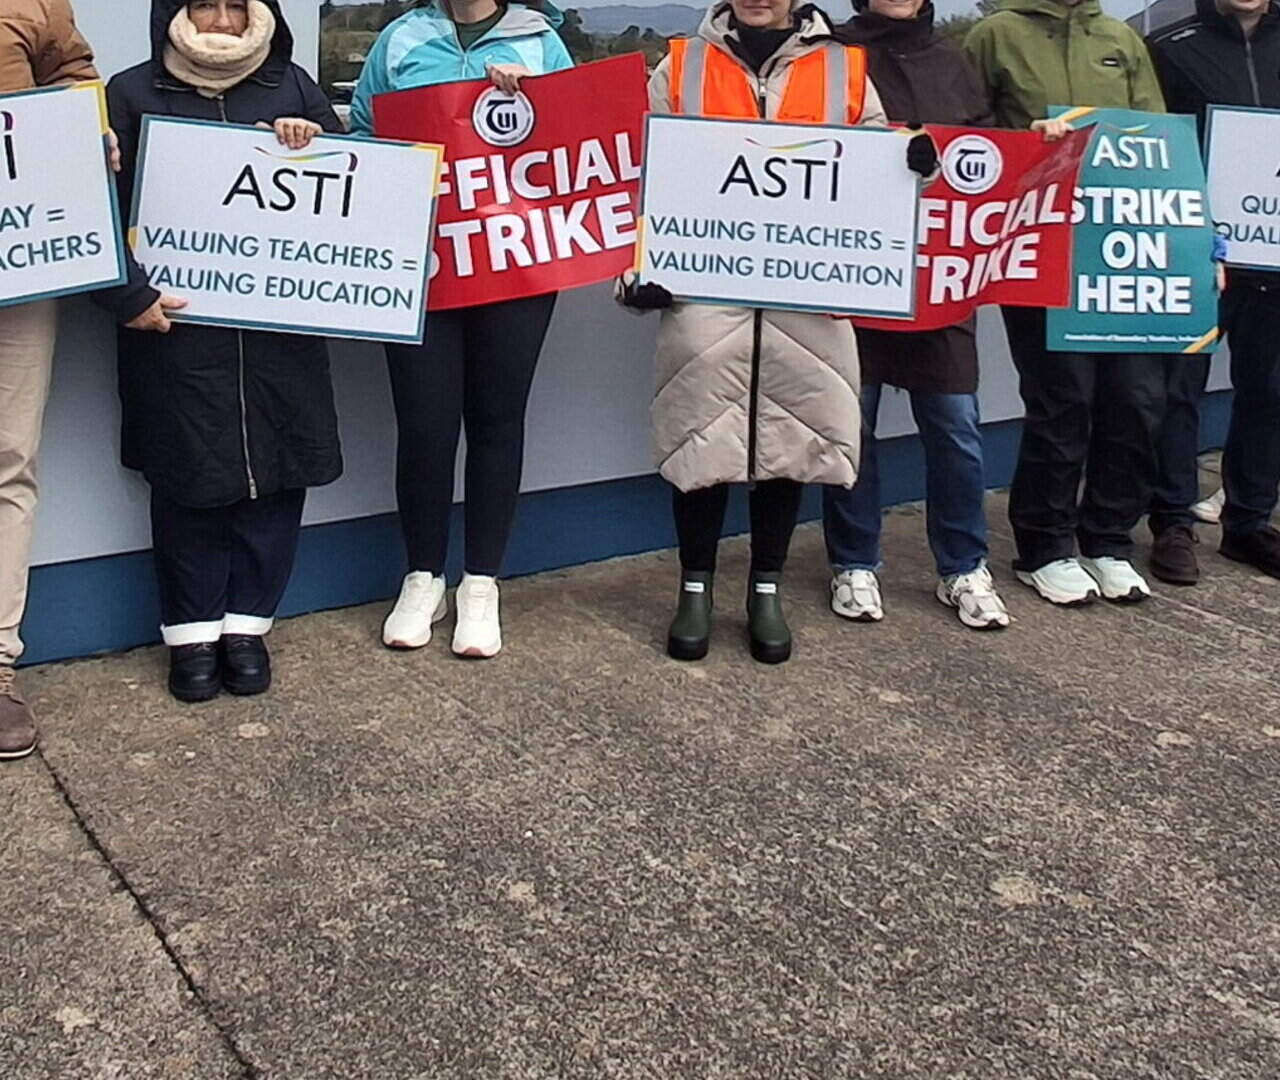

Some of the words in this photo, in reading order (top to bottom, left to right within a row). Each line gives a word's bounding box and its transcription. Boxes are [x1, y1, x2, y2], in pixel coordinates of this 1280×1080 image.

[436, 132, 641, 211] FICIAL
[1091, 134, 1170, 170] ASTI
[428, 191, 637, 280] TRIKE
[650, 215, 756, 243] VALUING
[763, 223, 882, 251] TEACHERS
[918, 183, 1066, 248] FICIAL
[143, 226, 260, 258] VALUING
[268, 238, 393, 270] TEACHERS
[648, 250, 754, 277] VALUING
[763, 258, 903, 288] EDUCATION
[915, 232, 1040, 305] RIKE
[1101, 231, 1168, 270] ON
[140, 263, 255, 295] VALUING
[264, 276, 414, 311] EDUCATION
[1077, 274, 1192, 315] HERE
